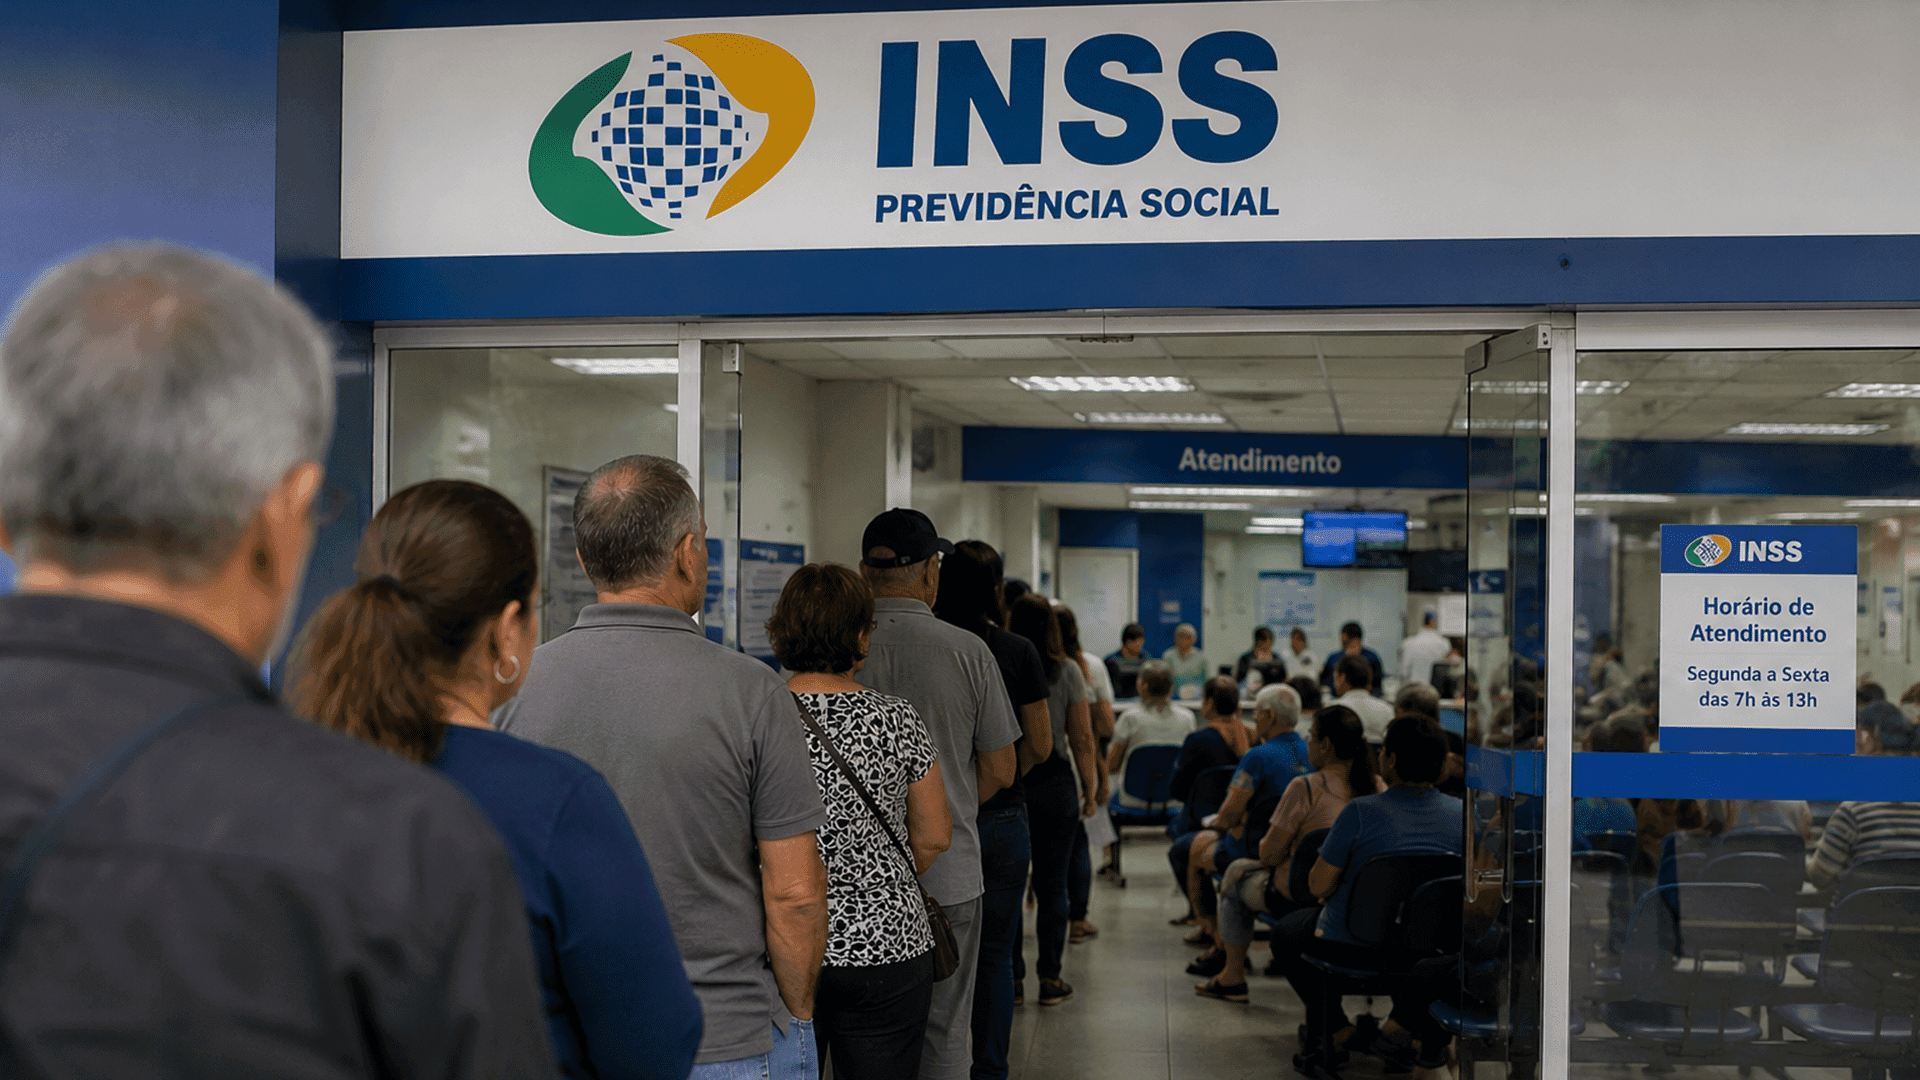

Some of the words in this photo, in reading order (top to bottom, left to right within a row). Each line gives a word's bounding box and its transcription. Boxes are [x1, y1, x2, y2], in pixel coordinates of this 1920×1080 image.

[877, 31, 1279, 168] INSS
[876, 184, 1127, 223] PREVIDÊNCIA
[1140, 187, 1279, 217] SOCIAL
[1178, 447, 1341, 474] Atendimento
[1739, 540, 1803, 563] INSS
[1704, 596, 1781, 615] Horário
[1789, 596, 1814, 615] de
[1690, 624, 1826, 642] Atendimento
[1687, 666, 1761, 685] Segunda
[1767, 669, 1777, 682] a
[1781, 666, 1829, 682] Sexta
[1699, 691, 1729, 706] das
[1734, 691, 1756, 707] 7h
[1786, 692, 1816, 707] 13h
